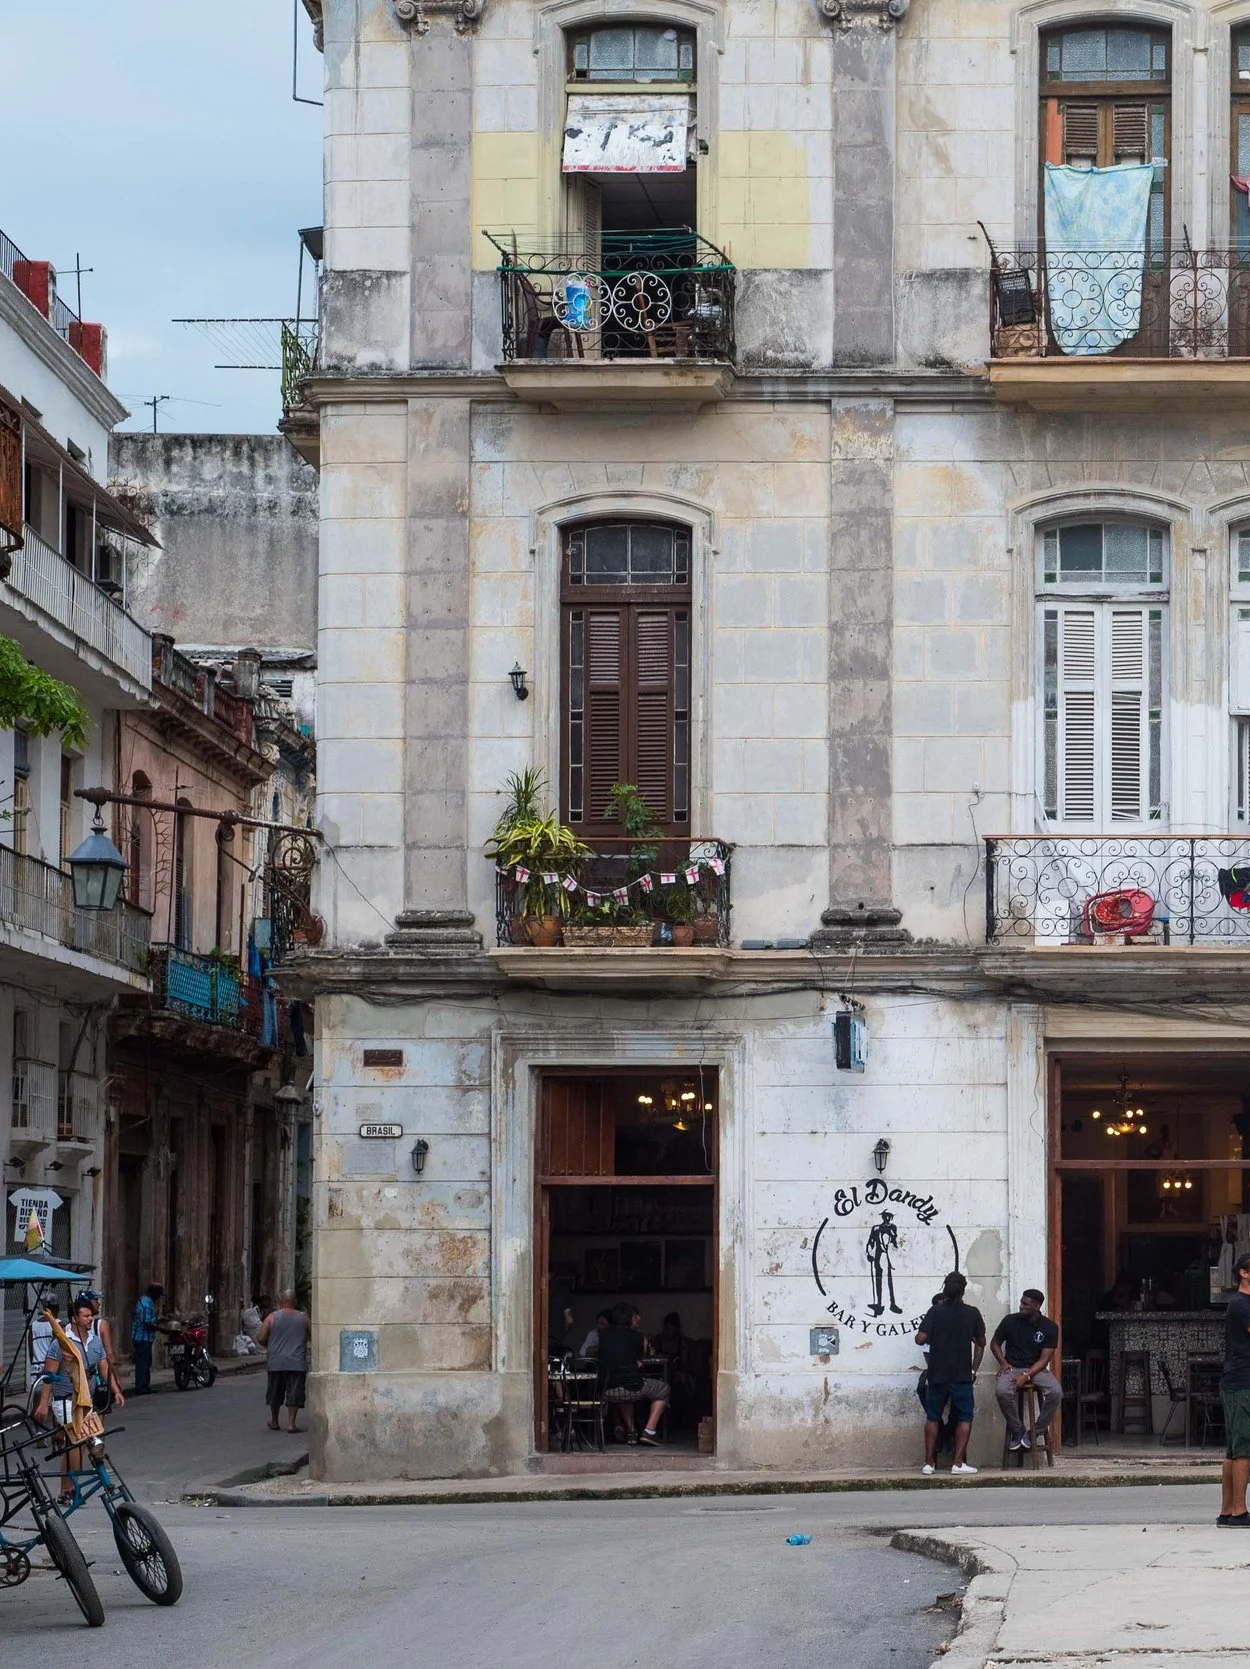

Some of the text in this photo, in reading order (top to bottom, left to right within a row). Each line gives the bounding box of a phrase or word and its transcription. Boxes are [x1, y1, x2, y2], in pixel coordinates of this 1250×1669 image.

[366, 1126, 396, 1136] BRASIL
[20, 1199, 49, 1208] TIENDA
[833, 1178, 938, 1226] El Dandy
[826, 1301, 857, 1329] BAR
[861, 1319, 872, 1334] Y
